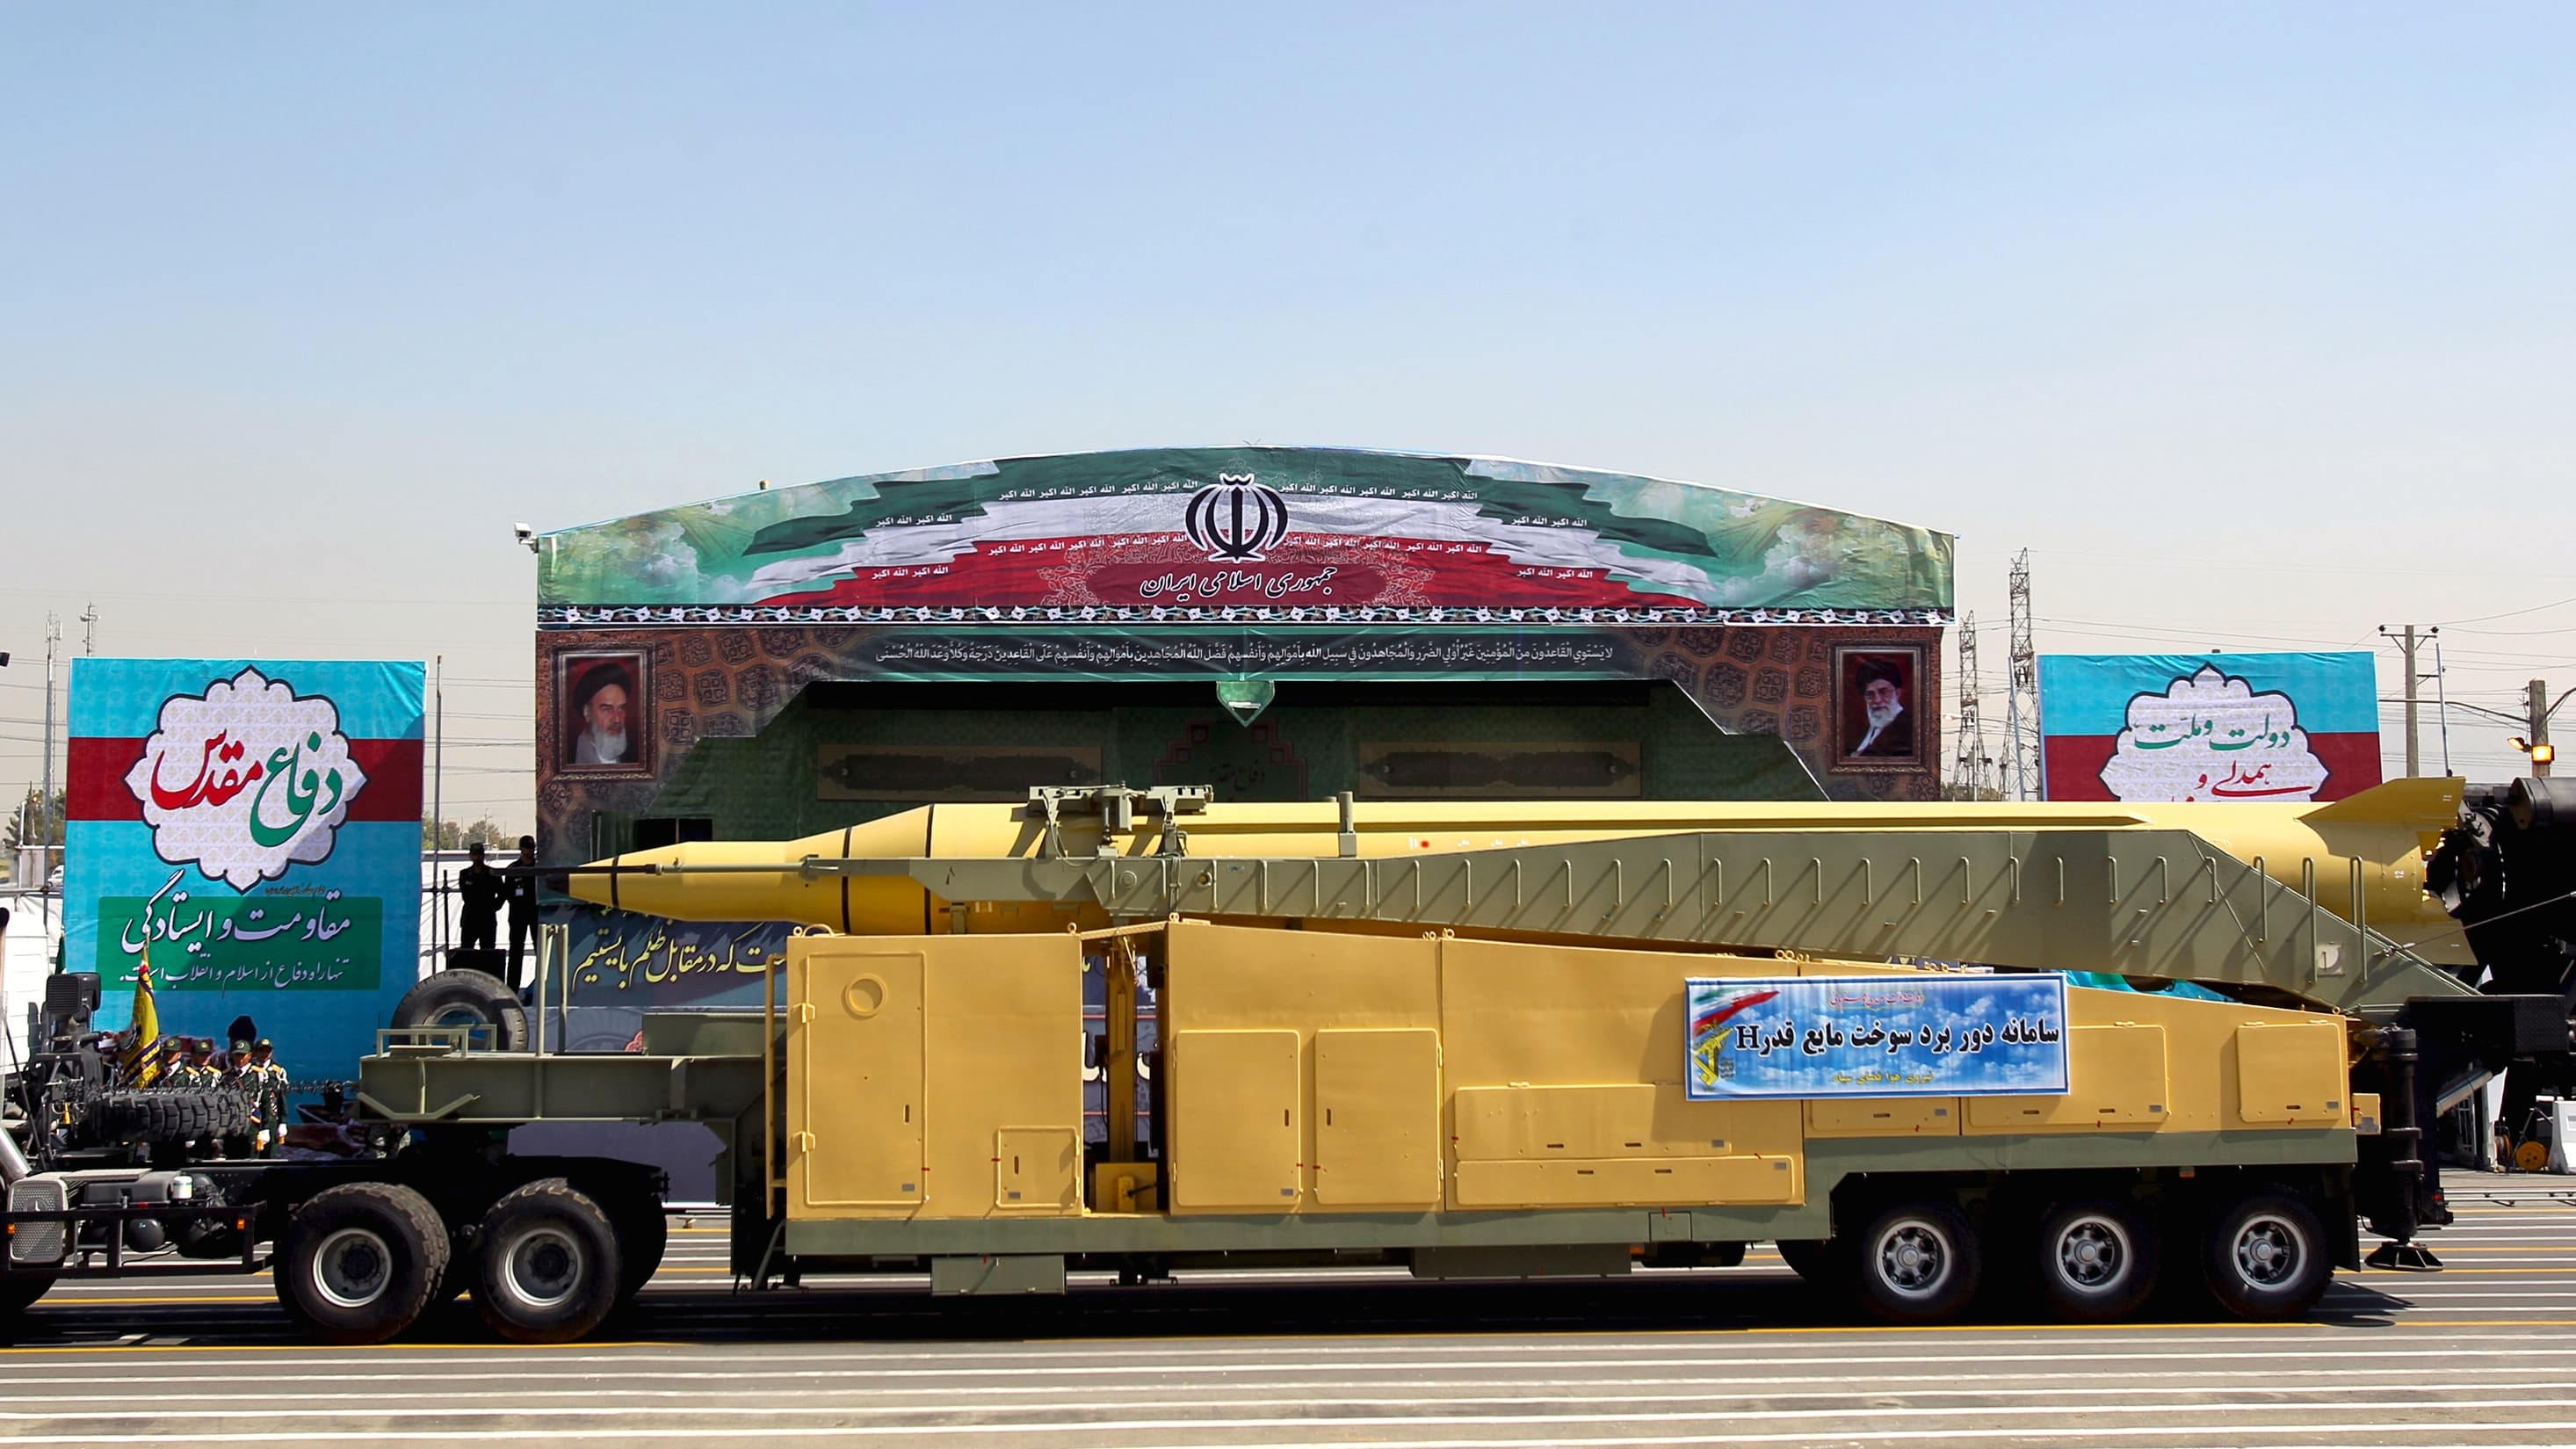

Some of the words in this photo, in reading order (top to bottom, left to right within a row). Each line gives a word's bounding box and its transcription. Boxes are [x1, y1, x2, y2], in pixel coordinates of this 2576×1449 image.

[1100, 483, 1116, 494] الله
[1142, 481, 1158, 491] الله
[1183, 479, 1198, 489] الله
[1300, 483, 1316, 493] الله
[1340, 485, 1356, 495] الله
[1020, 488, 1036, 498] الله
[1060, 485, 1075, 496] الله
[1379, 486, 1396, 496] الله
[1422, 489, 1438, 498] الله
[1461, 490, 1478, 500] الله
[896, 515, 912, 525] الله
[937, 513, 952, 523] الله
[1531, 517, 1548, 526] الله
[1571, 518, 1588, 528] الله
[1089, 537, 1105, 548] الله
[1132, 535, 1148, 546] الله
[1172, 533, 1188, 544] الله
[1304, 537, 1321, 547] الله
[1344, 539, 1361, 549] الله
[1009, 541, 1025, 553] الله
[1049, 540, 1065, 550] الله
[1384, 540, 1400, 550] الله
[1426, 542, 1443, 553] الله
[1466, 543, 1482, 554] الله
[893, 567, 908, 577] الله
[933, 564, 949, 576] الله
[1538, 568, 1553, 578] الله
[1577, 569, 1593, 580] الله
[1140, 573, 1197, 601] ایران
[1198, 570, 1262, 598] اسلامی
[1266, 568, 1337, 598] جمهوری
[2209, 714, 2290, 750] دولت
[151, 728, 264, 810] مقدس
[2196, 773, 2208, 789] و
[2211, 760, 2313, 797] همدلی
[250, 731, 343, 847] دفاع
[120, 869, 213, 954] ایستادگی
[234, 889, 351, 941] مقاومت
[217, 917, 233, 941] و
[572, 928, 628, 993] بایستیم
[646, 938, 704, 982] مقابل
[697, 953, 716, 973] در
[165, 953, 213, 989] انقلاب
[214, 969, 222, 981] و
[260, 960, 273, 981] از
[274, 961, 308, 988] دفاع
[327, 958, 350, 981] تنها
[221, 965, 258, 999] اسلام
[1851, 1019, 1912, 1054] سوخت
[2001, 1017, 2059, 1044] سامانه
[1802, 1022, 1843, 1055] مایع
[1920, 1025, 1951, 1054] برد
[1958, 1025, 1993, 1053] دور
